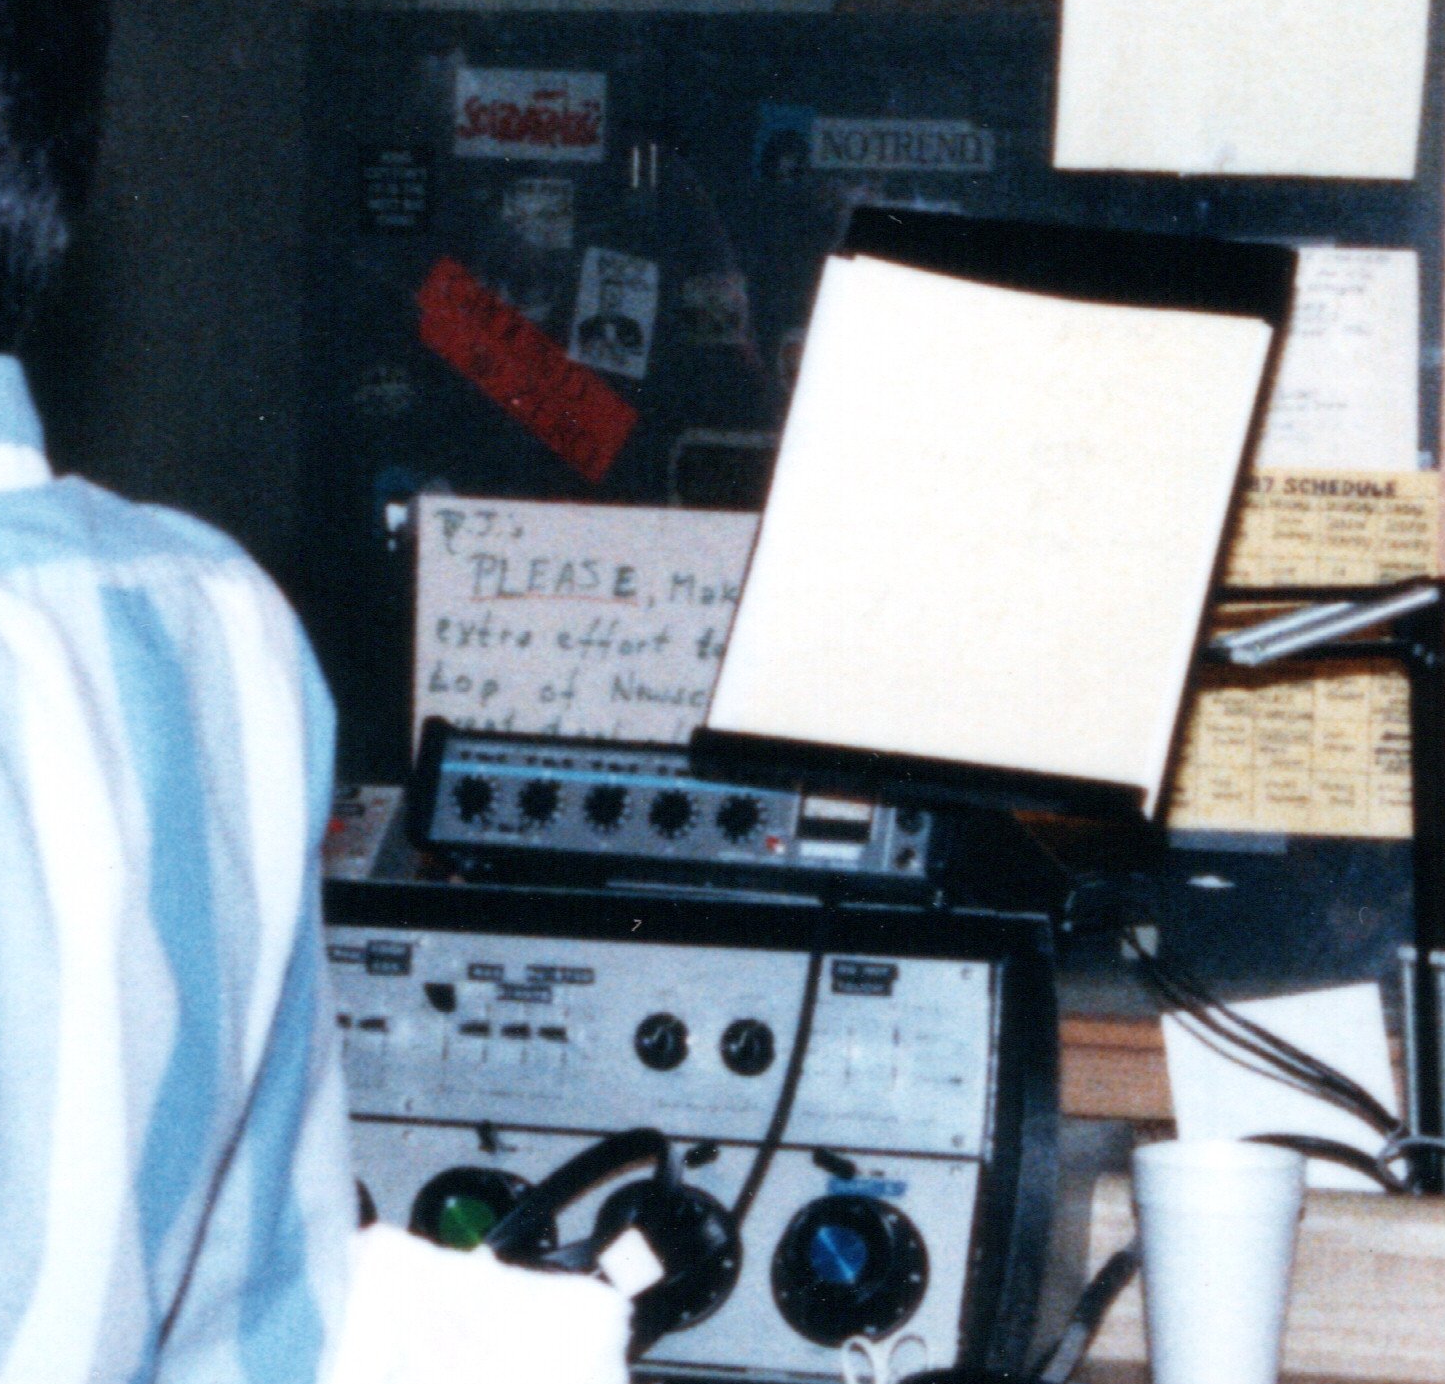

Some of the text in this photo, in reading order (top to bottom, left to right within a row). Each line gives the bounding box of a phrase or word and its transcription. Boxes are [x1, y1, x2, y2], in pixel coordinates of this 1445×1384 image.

[1284, 478, 1397, 497] SCHEDULE
[669, 571, 738, 606] Mak
[435, 610, 532, 650] extra
[556, 617, 671, 661] effort
[538, 666, 580, 709] of
